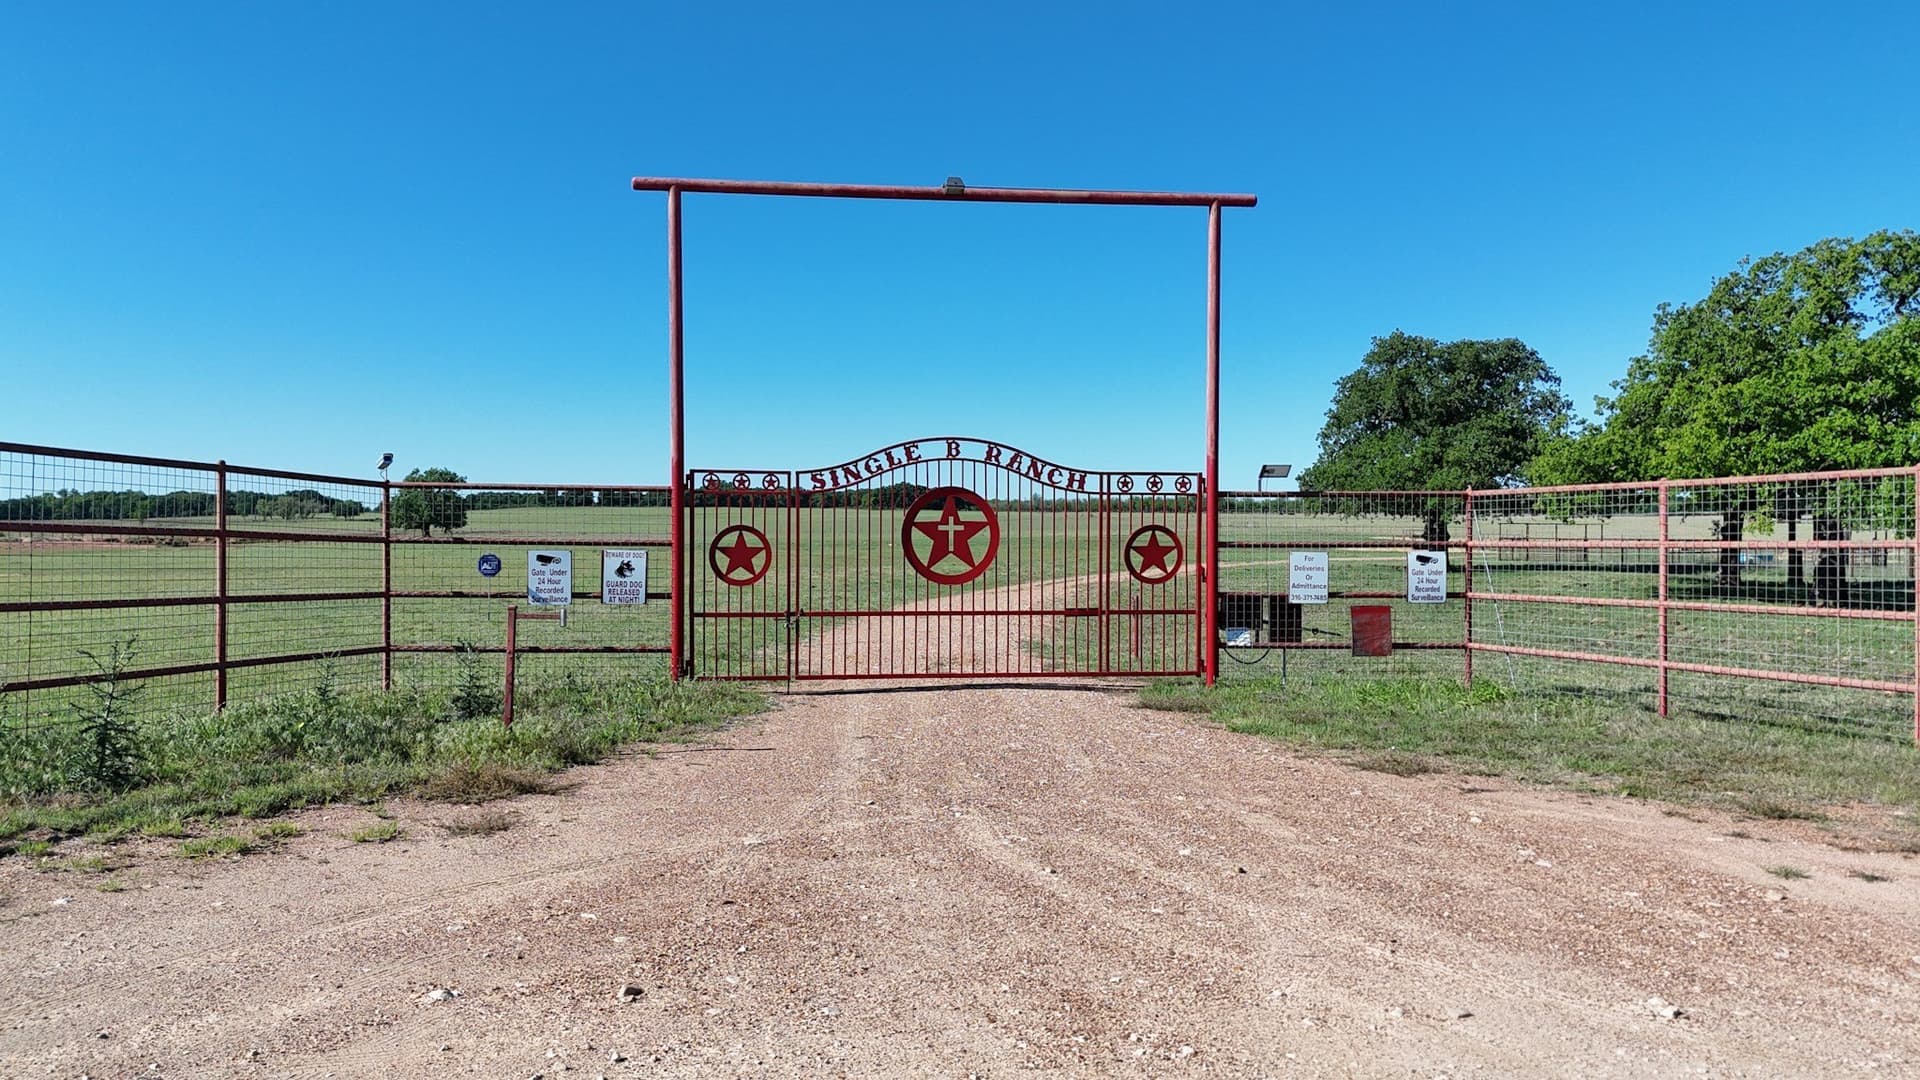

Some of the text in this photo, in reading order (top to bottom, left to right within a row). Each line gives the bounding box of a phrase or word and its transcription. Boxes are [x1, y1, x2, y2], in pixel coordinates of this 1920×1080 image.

[810, 439, 1088, 491] SINGLE B RANCH
[605, 551, 624, 559] BEWARE
[625, 551, 631, 559] OF
[481, 561, 498, 570] ADT
[1294, 564, 1325, 572] Deliveries
[531, 568, 568, 576] Gate Under
[1411, 568, 1443, 576] Gate Under
[537, 577, 562, 585] 24 Hour
[1417, 576, 1438, 584] 24 Hour
[606, 580, 643, 589] GUARD DOG
[1291, 582, 1327, 590] Admittance
[535, 586, 564, 594] Recorded
[607, 588, 640, 596] RELEASED
[1414, 585, 1441, 593] Recorded
[531, 595, 569, 603] Surveillance
[618, 596, 640, 604] NIGHT!
[1410, 594, 1444, 602] Surveillance
